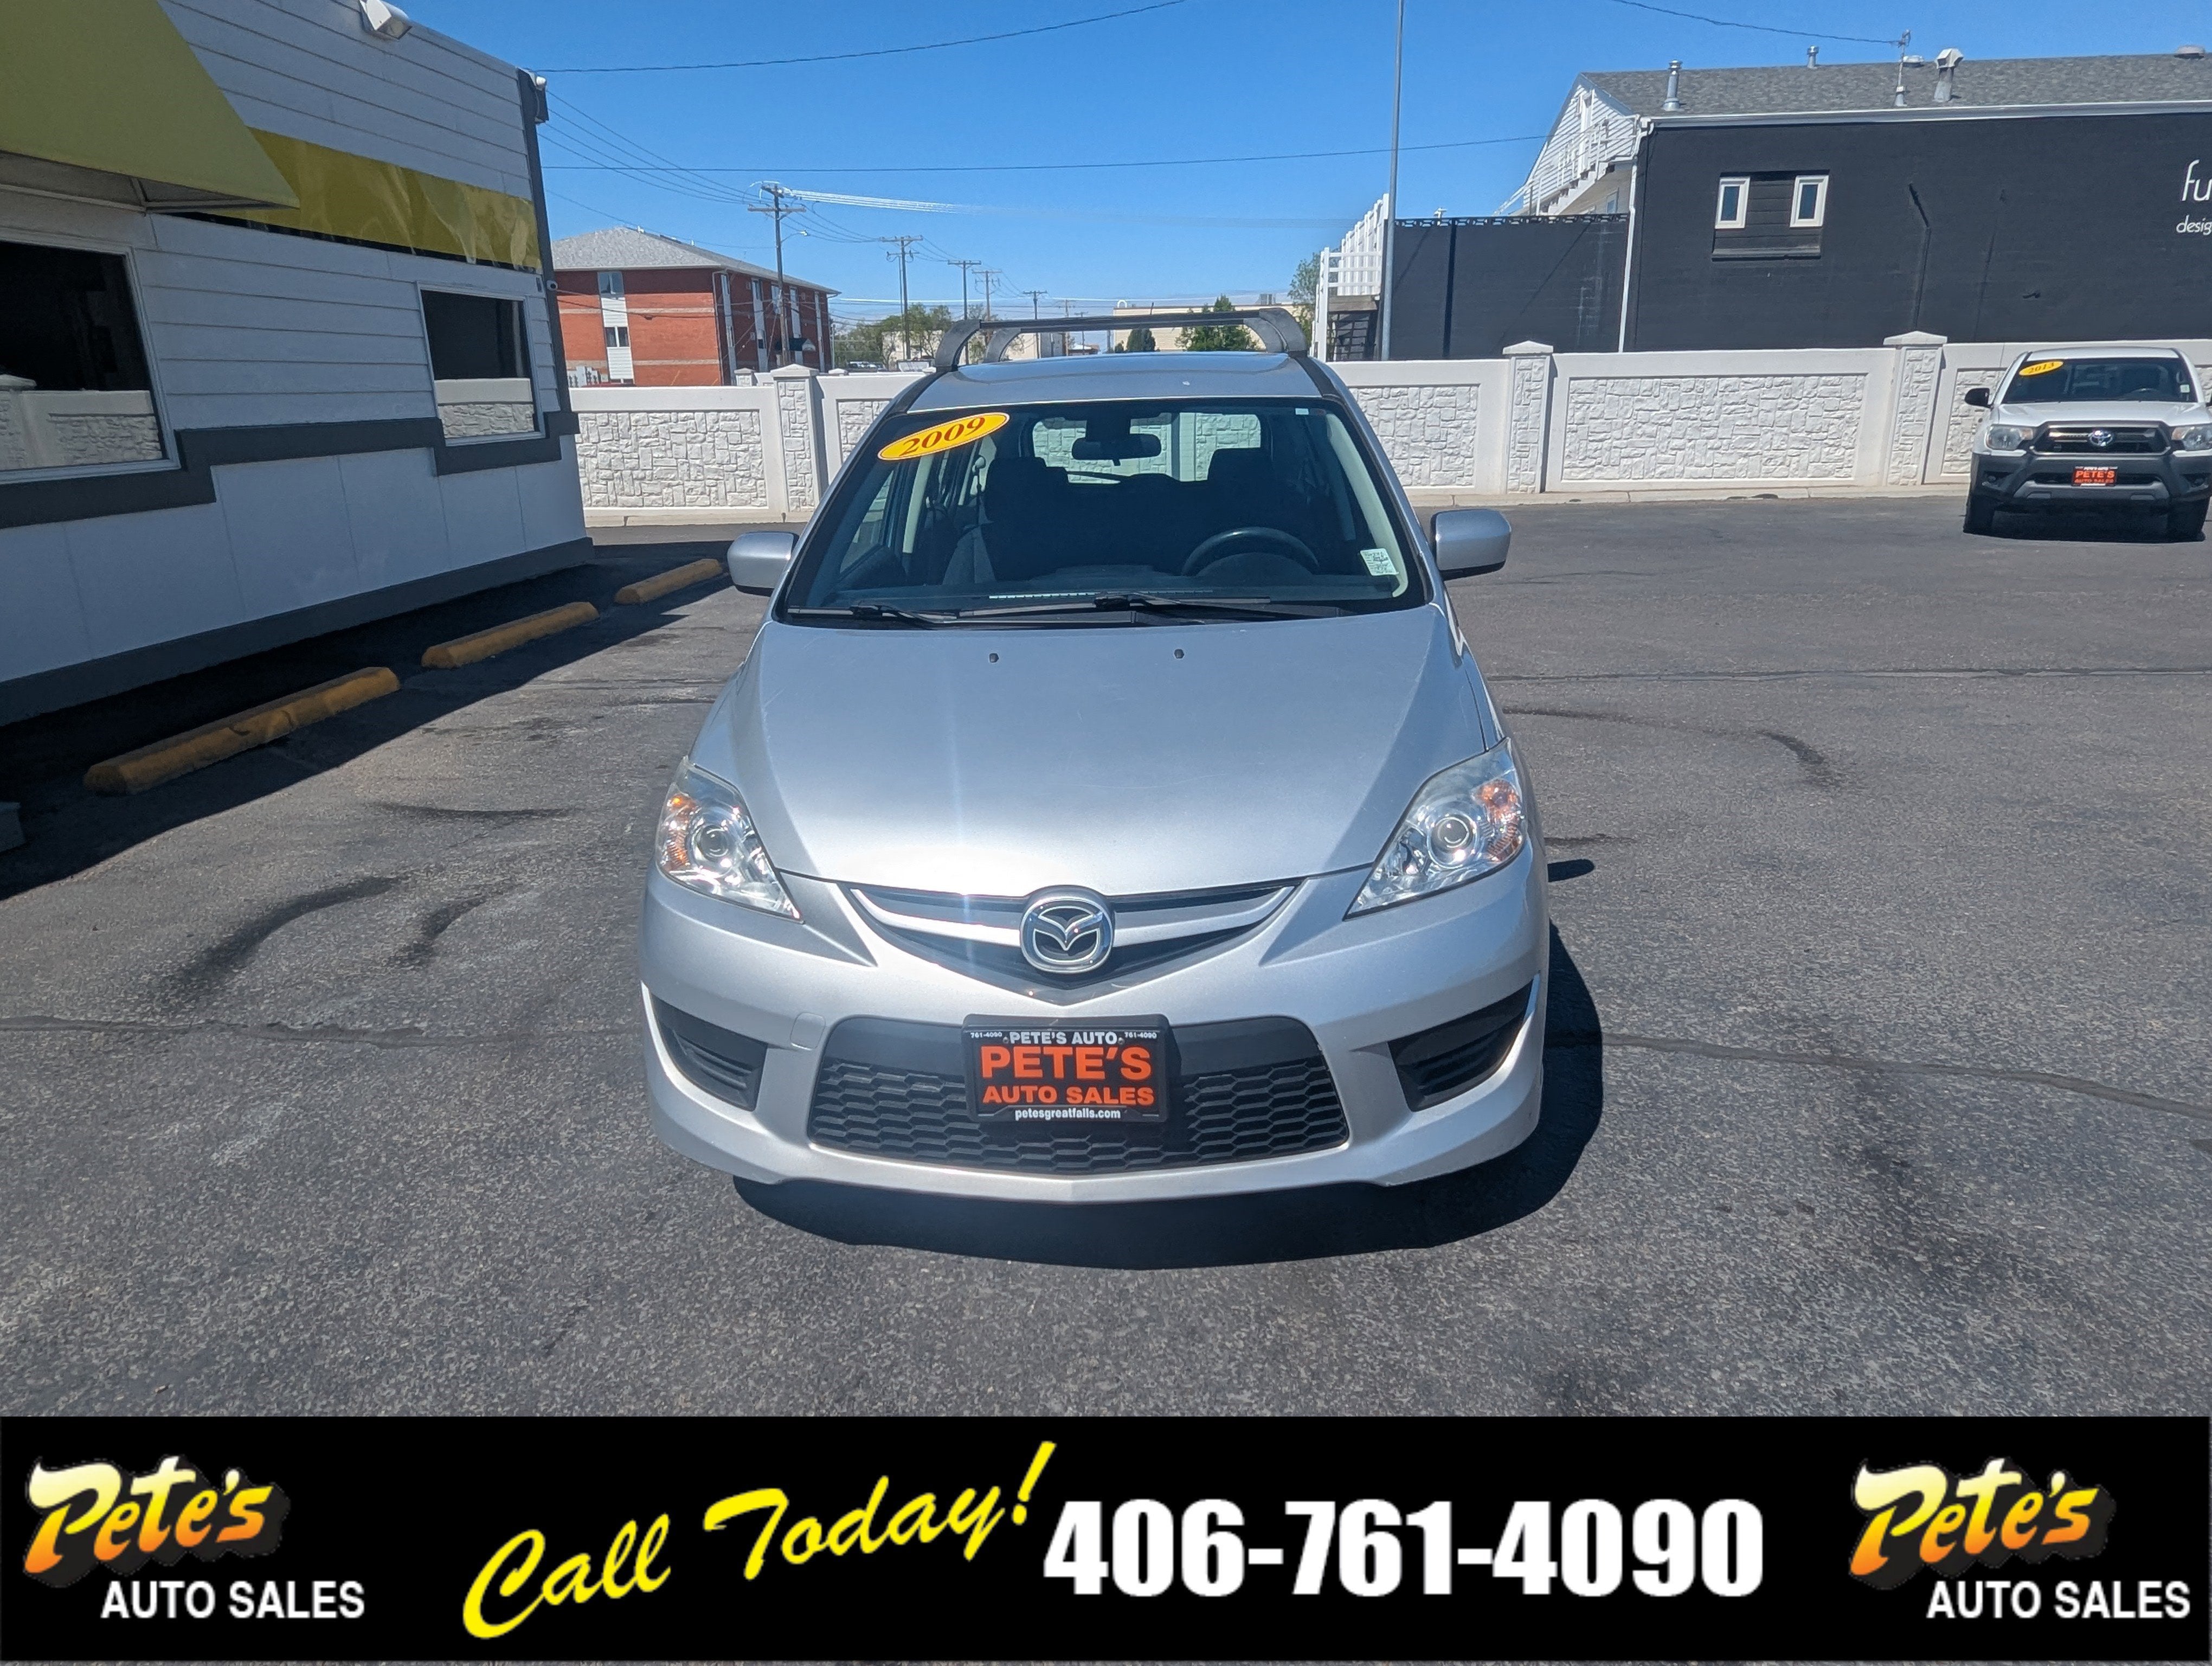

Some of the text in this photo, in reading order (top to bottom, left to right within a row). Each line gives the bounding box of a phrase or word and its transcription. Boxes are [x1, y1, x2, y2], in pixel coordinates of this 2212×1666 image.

[2176, 214, 2212, 235] desig
[2028, 362, 2055, 374] 2013
[898, 416, 986, 457] 2009
[2075, 470, 2115, 478] PETE'S
[1009, 1031, 1118, 1045] PETE'S AUTO
[1124, 1031, 1158, 1040] 761-4090
[981, 1046, 1152, 1080] PETE'S
[982, 1085, 1154, 1105] AUTO SALES
[1015, 1107, 1121, 1121] petesgreatfalls.com
